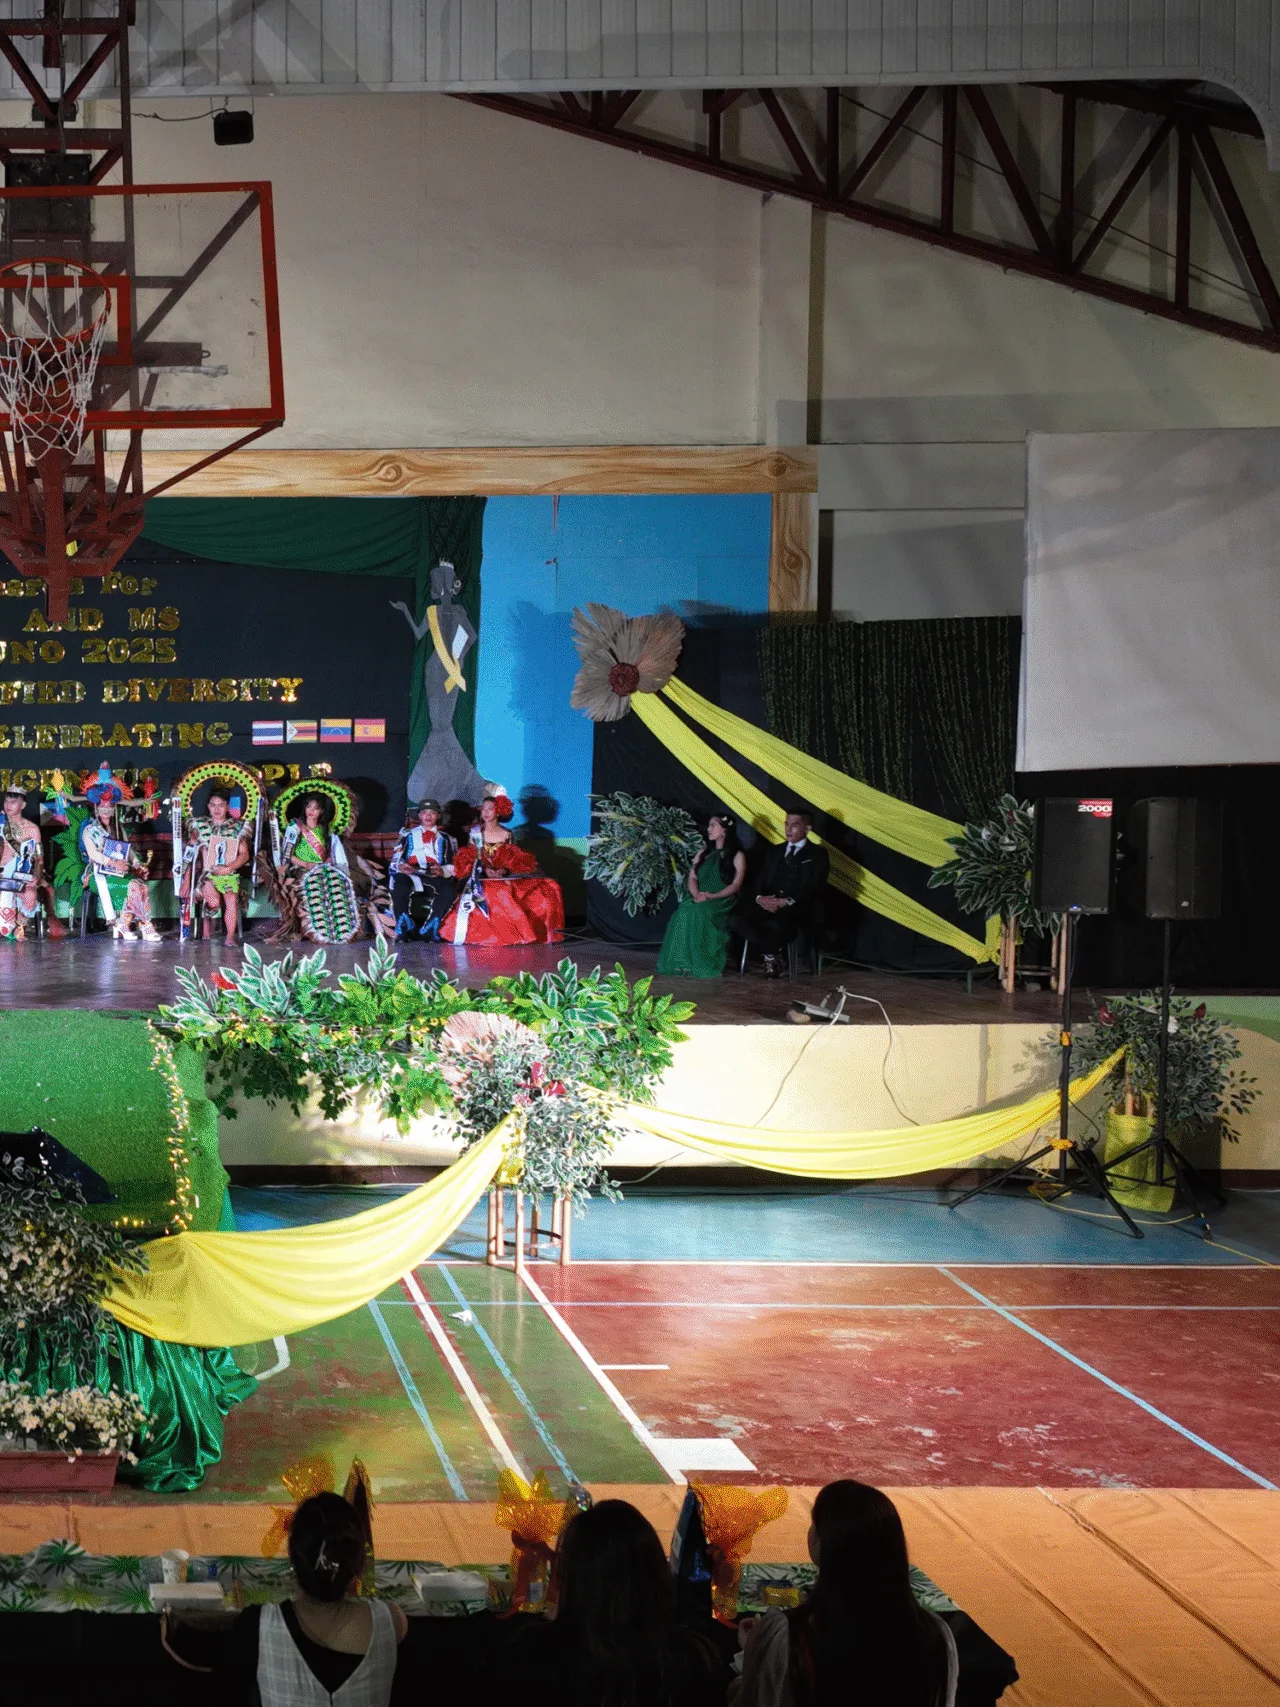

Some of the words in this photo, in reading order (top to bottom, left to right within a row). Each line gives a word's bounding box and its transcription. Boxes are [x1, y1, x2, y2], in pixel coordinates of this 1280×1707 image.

[100, 571, 158, 596] For
[127, 606, 181, 632] MS
[81, 637, 177, 664] 2025
[102, 677, 304, 704] DIVERSITY
[462, 901, 473, 912] 5
